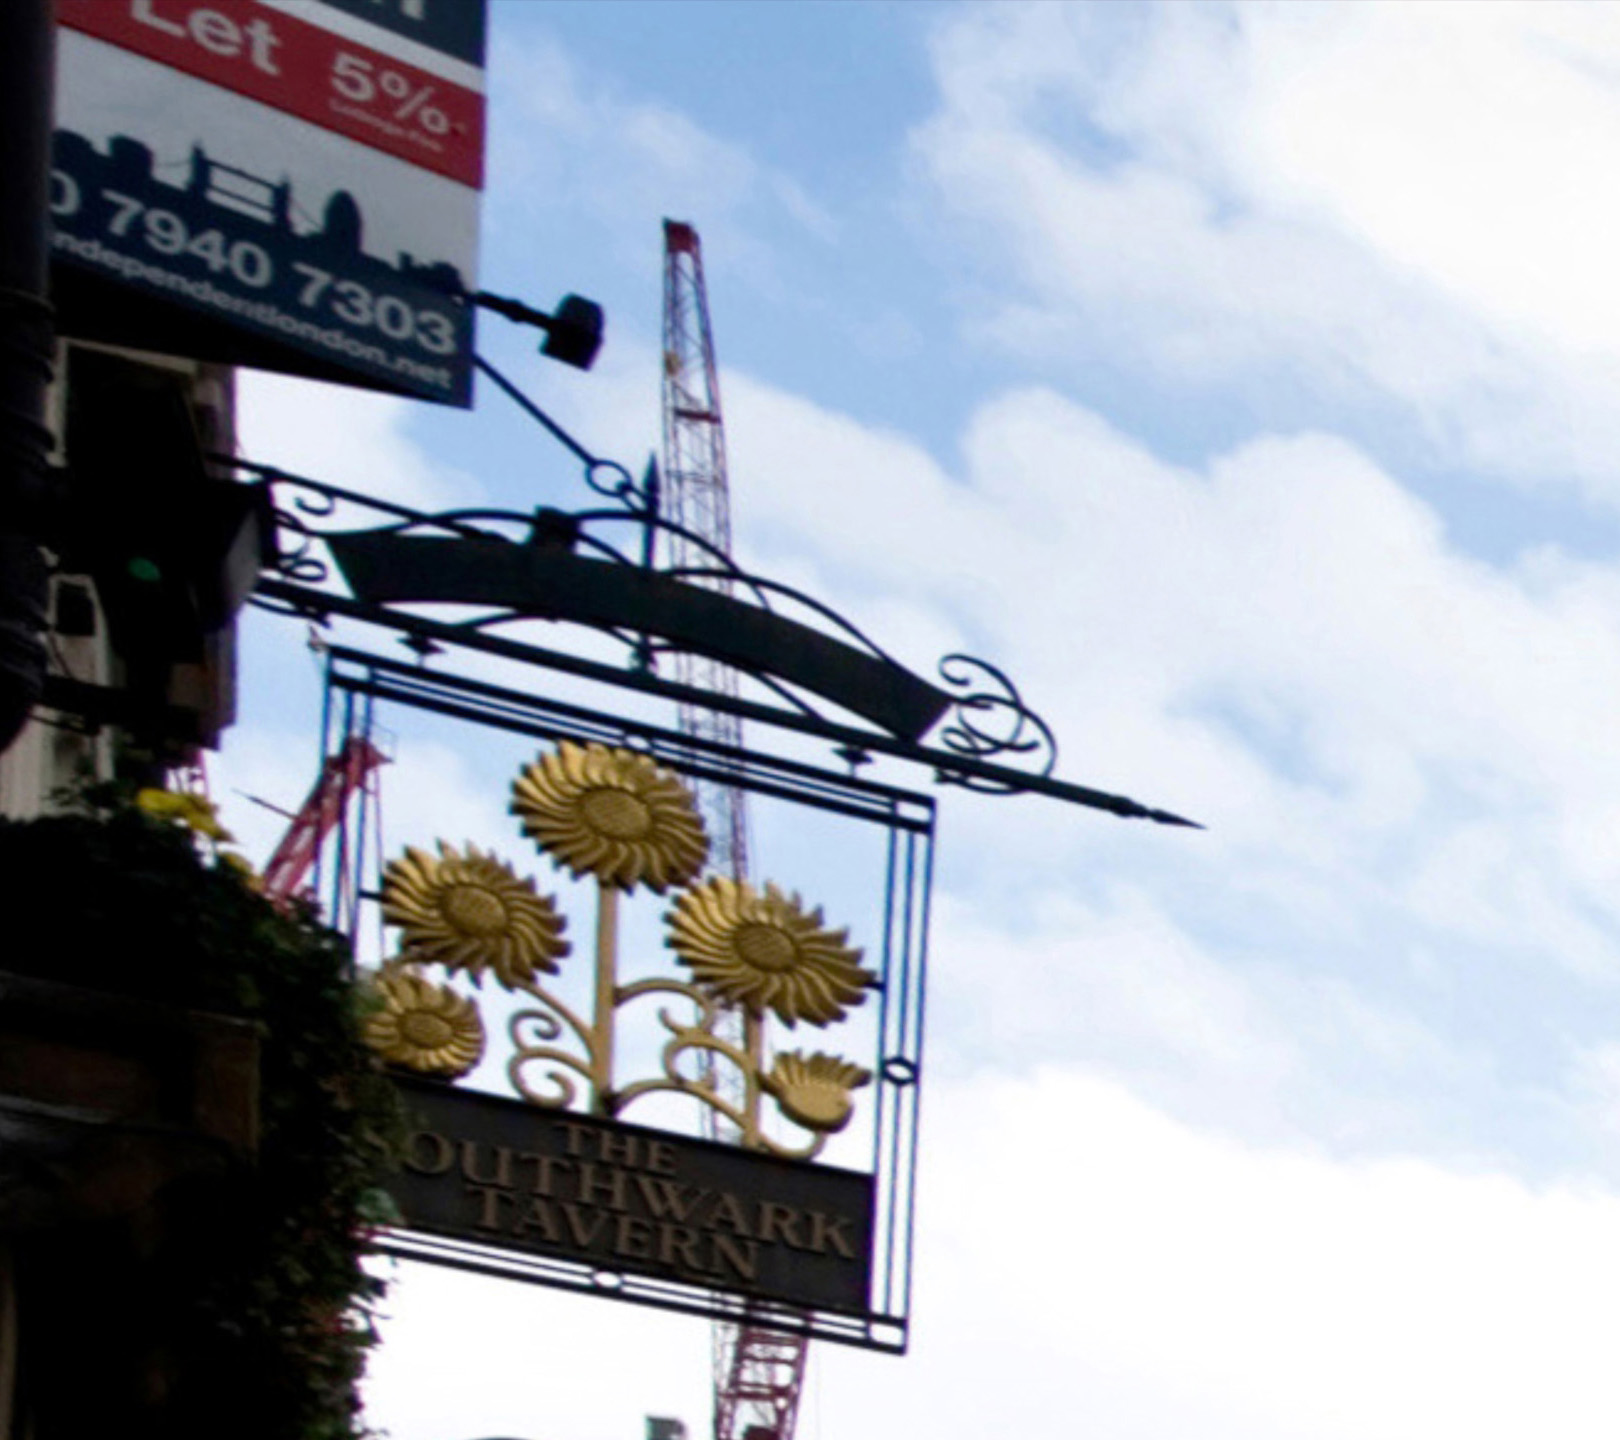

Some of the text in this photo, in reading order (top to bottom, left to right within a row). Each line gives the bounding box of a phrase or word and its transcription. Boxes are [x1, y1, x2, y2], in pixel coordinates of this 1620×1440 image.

[329, 52, 450, 138] 5%
[50, 231, 453, 391] ndependentlondon.net
[102, 188, 272, 288] 7940
[292, 261, 456, 356] 7303
[372, 1128, 856, 1260] OUTHWARK
[555, 1123, 678, 1173] THE
[466, 1184, 762, 1281] TAVERN
